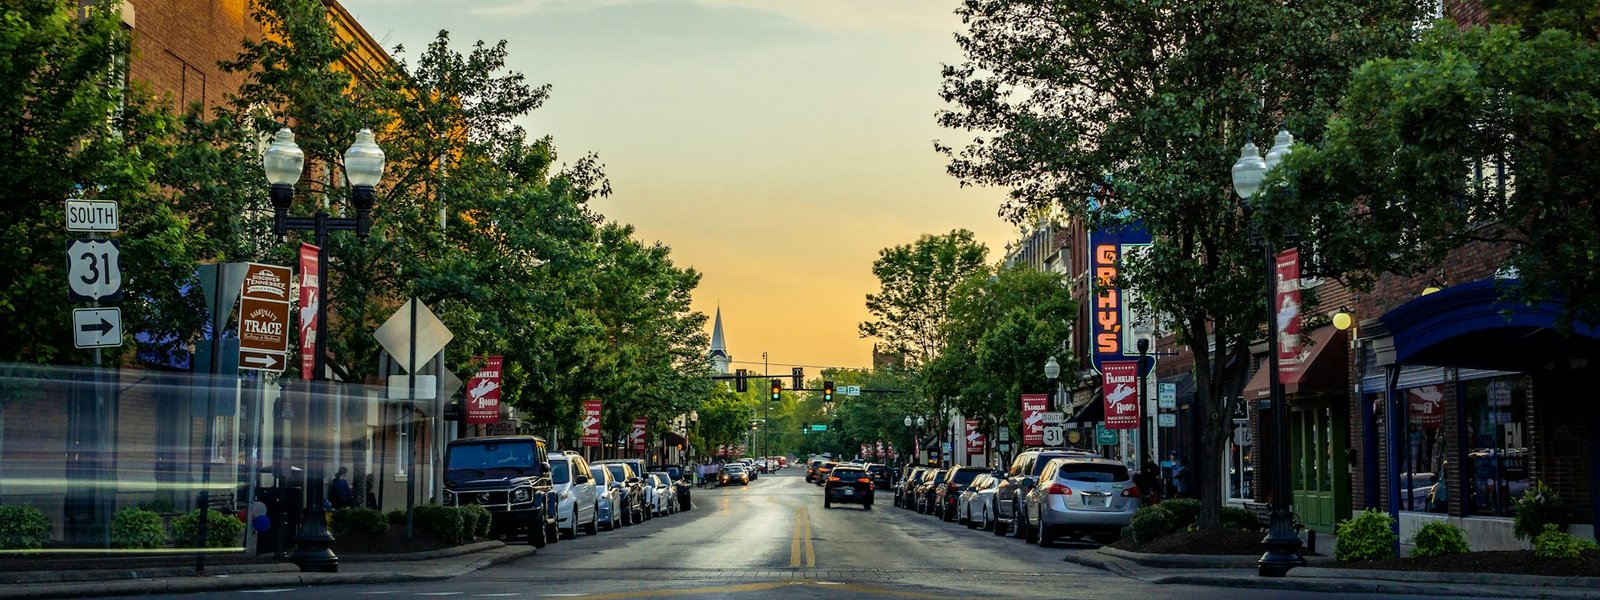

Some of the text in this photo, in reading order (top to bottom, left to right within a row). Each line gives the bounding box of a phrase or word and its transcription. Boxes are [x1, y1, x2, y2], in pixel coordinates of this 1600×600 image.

[70, 207, 114, 224] SOUTH
[80, 252, 110, 285] 31
[246, 278, 286, 290] TENNESSEE
[252, 274, 281, 283] DISCOVER
[245, 319, 282, 335] TRACE
[1106, 373, 1135, 384] FRANKLIN
[1046, 430, 1059, 441] 31
